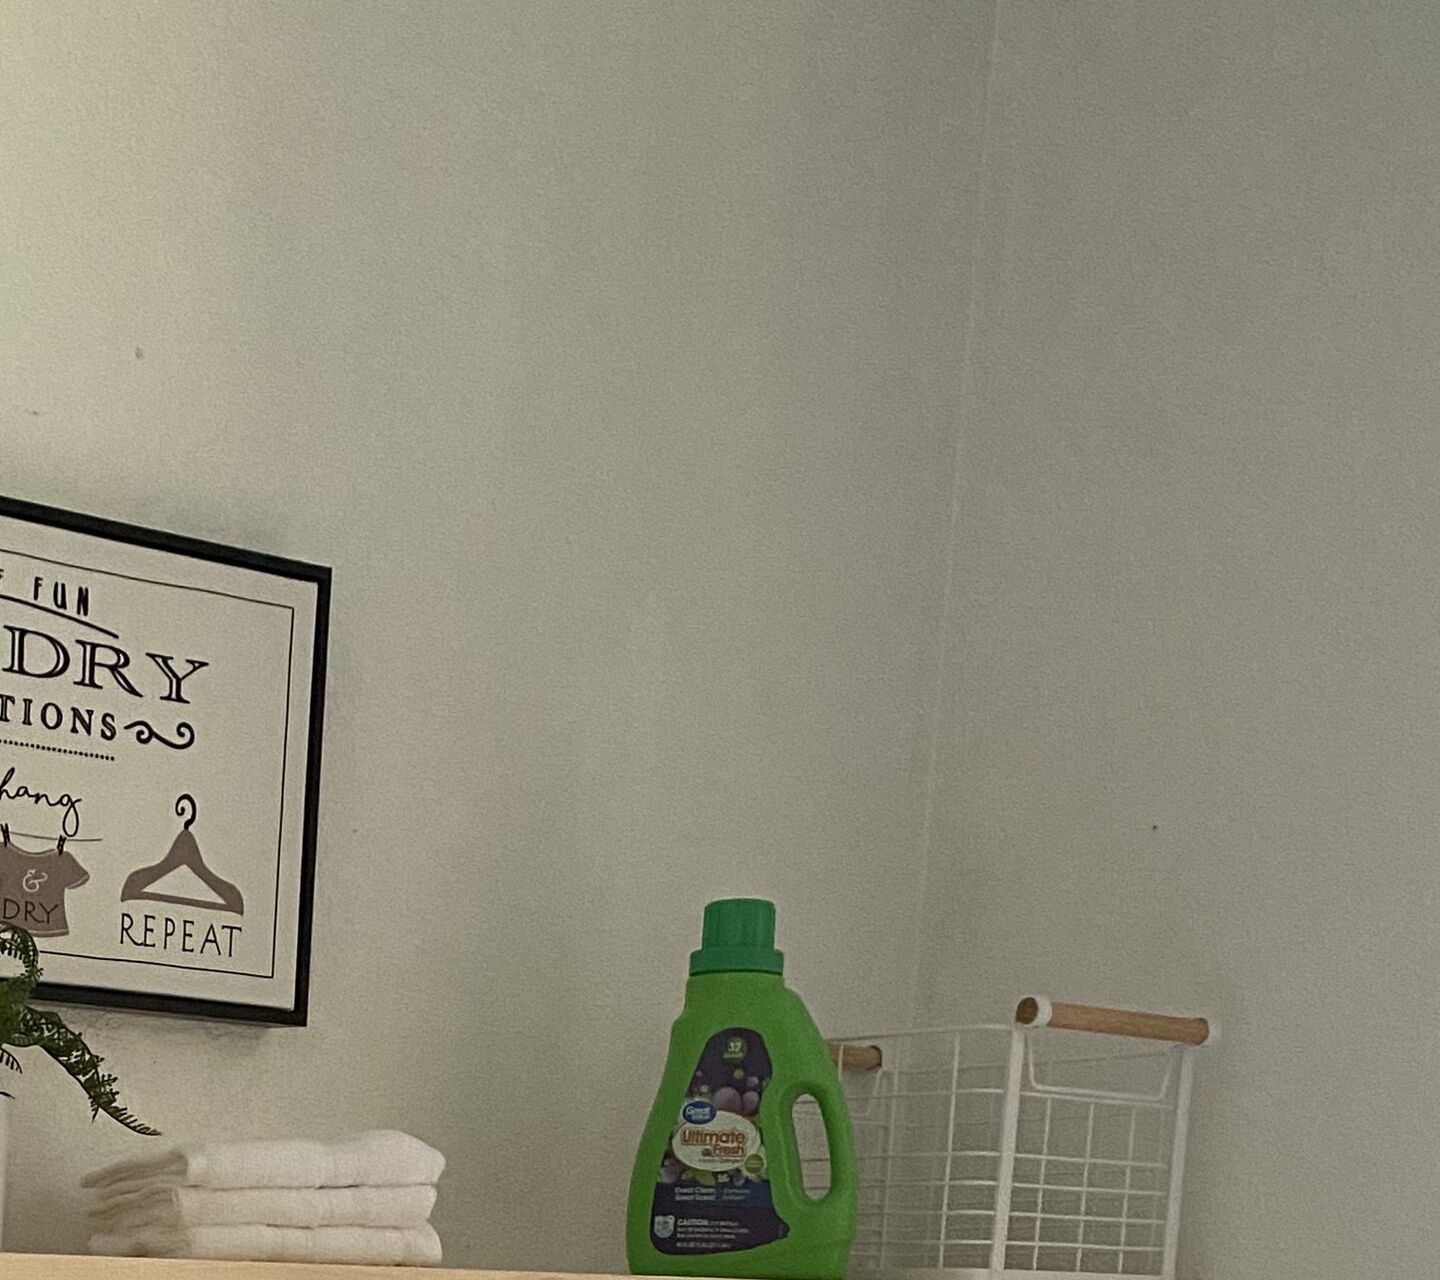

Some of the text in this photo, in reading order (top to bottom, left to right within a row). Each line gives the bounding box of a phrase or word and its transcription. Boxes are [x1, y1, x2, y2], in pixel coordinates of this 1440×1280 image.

[33, 577, 90, 618] FUN
[1, 897, 60, 927] DRY
[119, 912, 243, 960] REPEAT
[682, 1128, 746, 1145] Ultimate
[713, 1144, 745, 1156] Fresh
